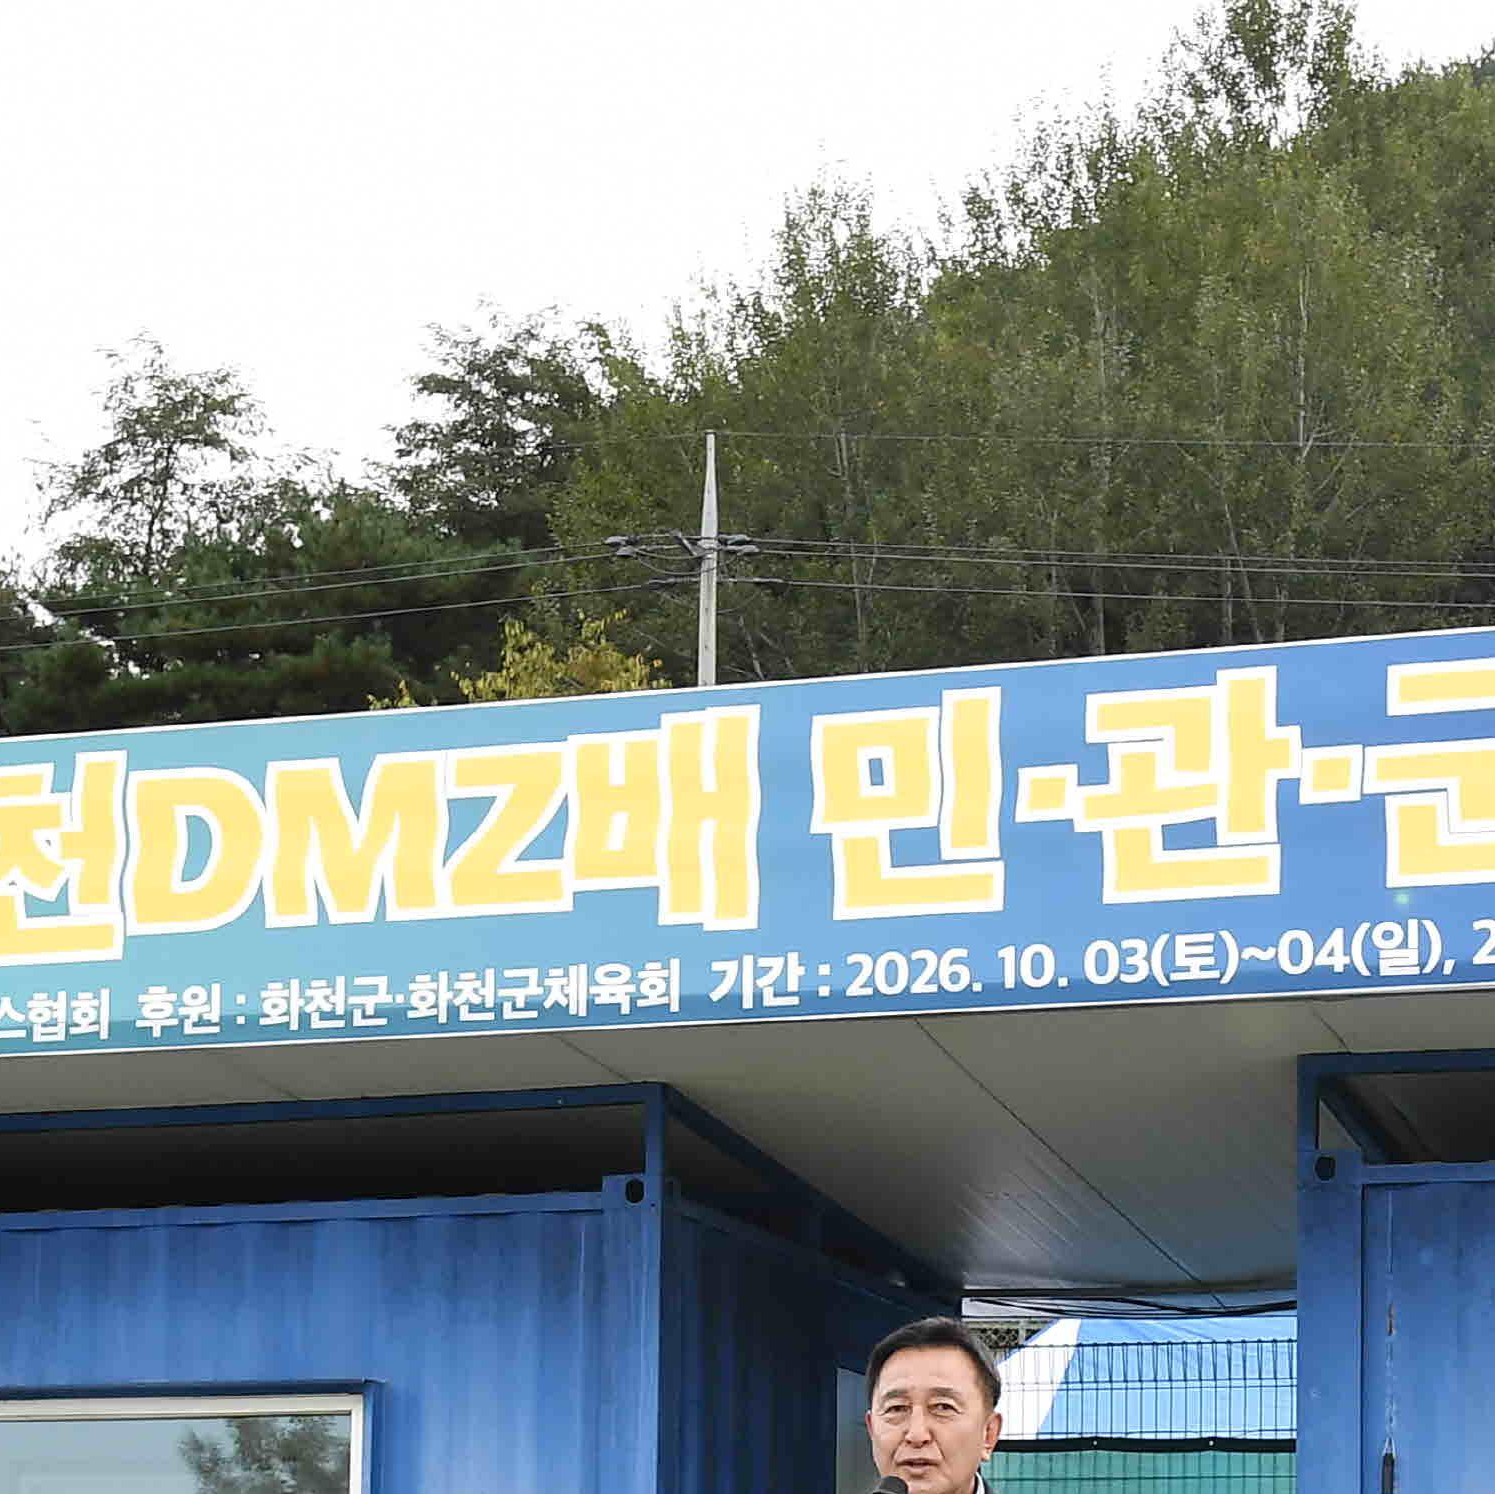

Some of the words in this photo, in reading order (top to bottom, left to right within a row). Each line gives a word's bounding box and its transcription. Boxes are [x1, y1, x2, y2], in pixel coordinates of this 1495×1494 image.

[136, 982, 221, 1038] 후원
[708, 952, 805, 1009] 기간
[845, 947, 984, 997] 2026.
[998, 944, 1069, 989] 10.
